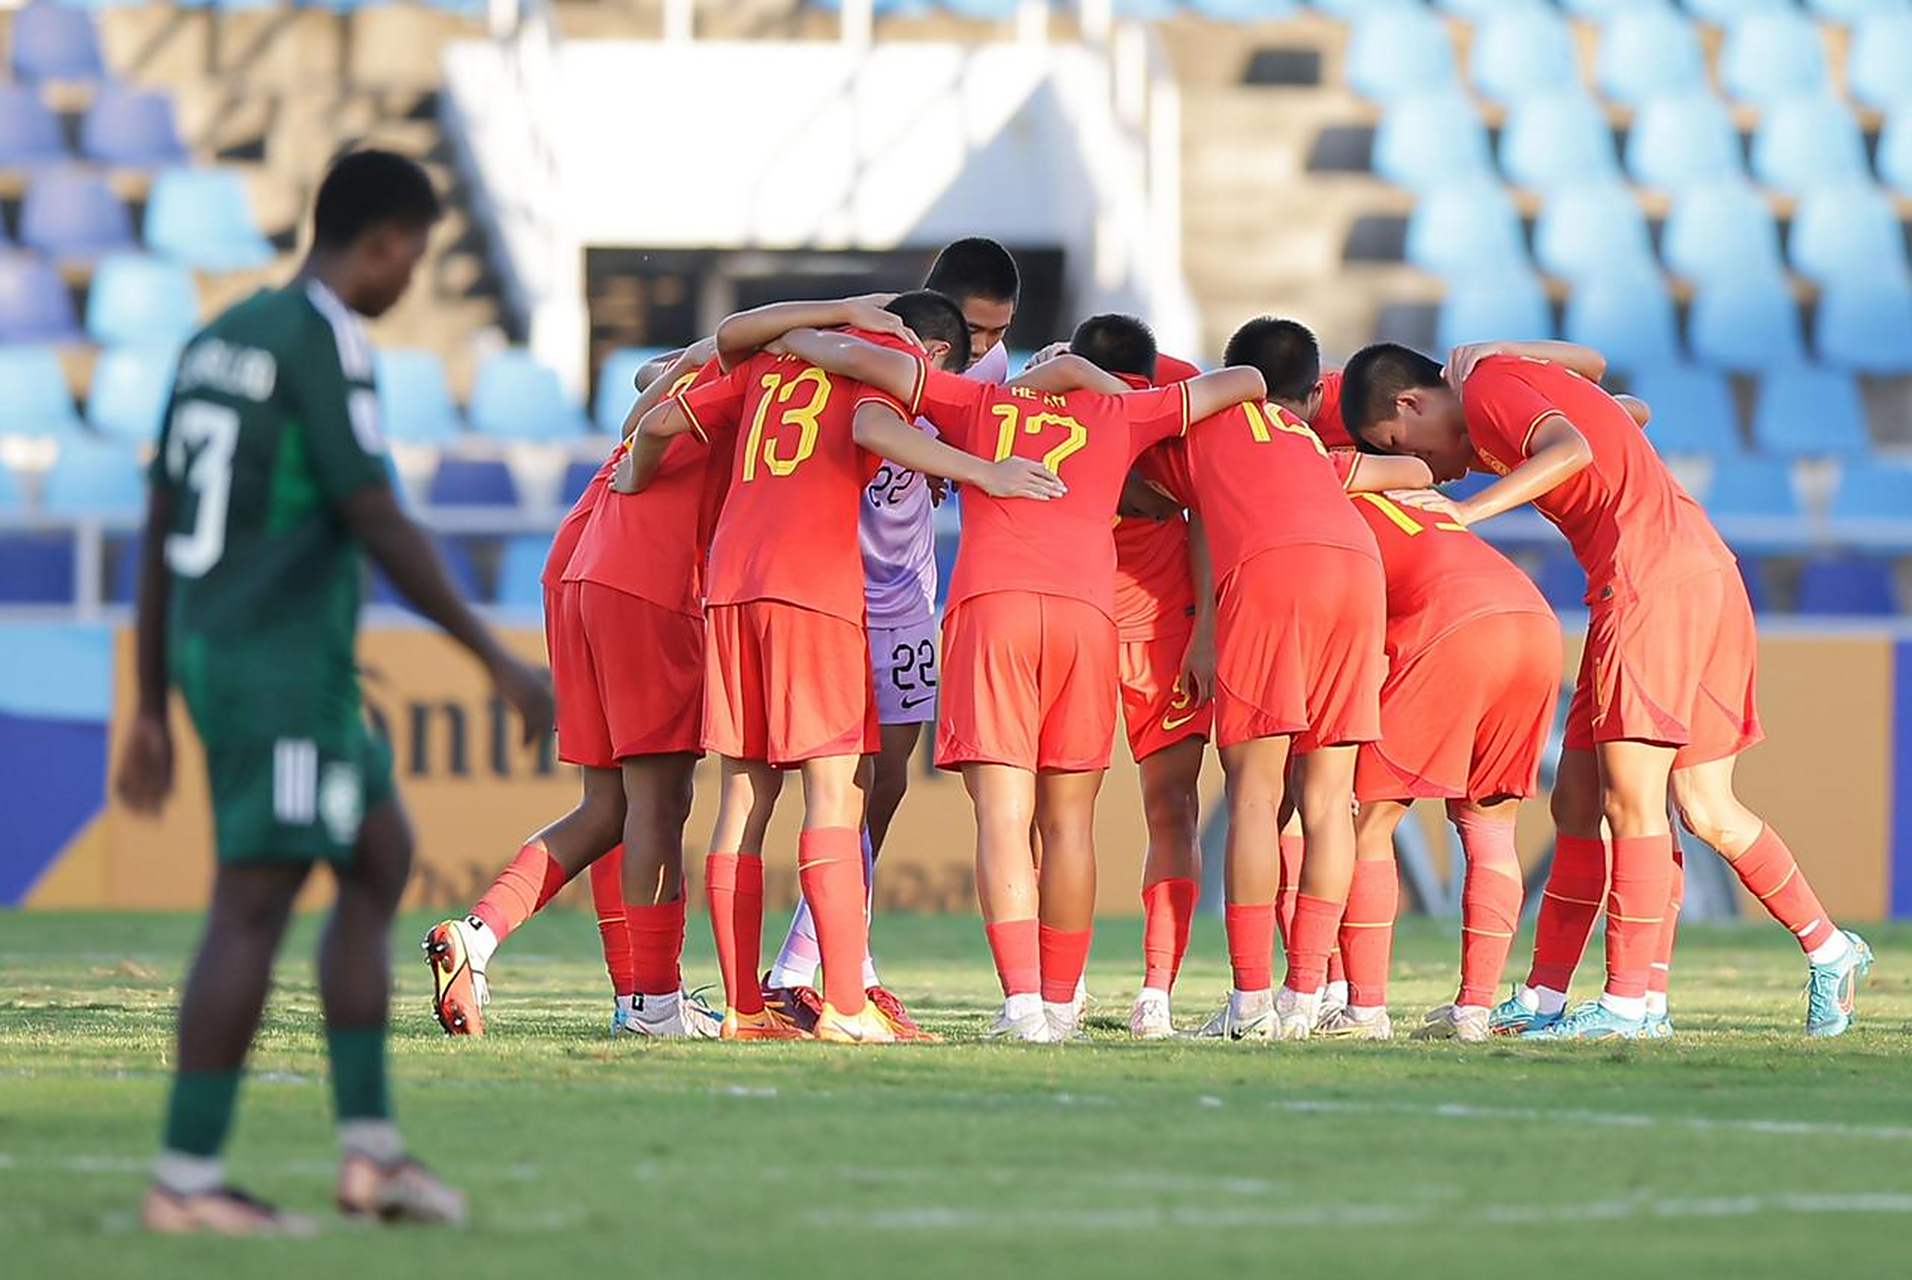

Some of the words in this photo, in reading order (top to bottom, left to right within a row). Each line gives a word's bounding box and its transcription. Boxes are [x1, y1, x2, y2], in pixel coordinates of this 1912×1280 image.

[742, 366, 832, 483] 13
[868, 465, 916, 508] 22
[891, 638, 937, 691] 22
